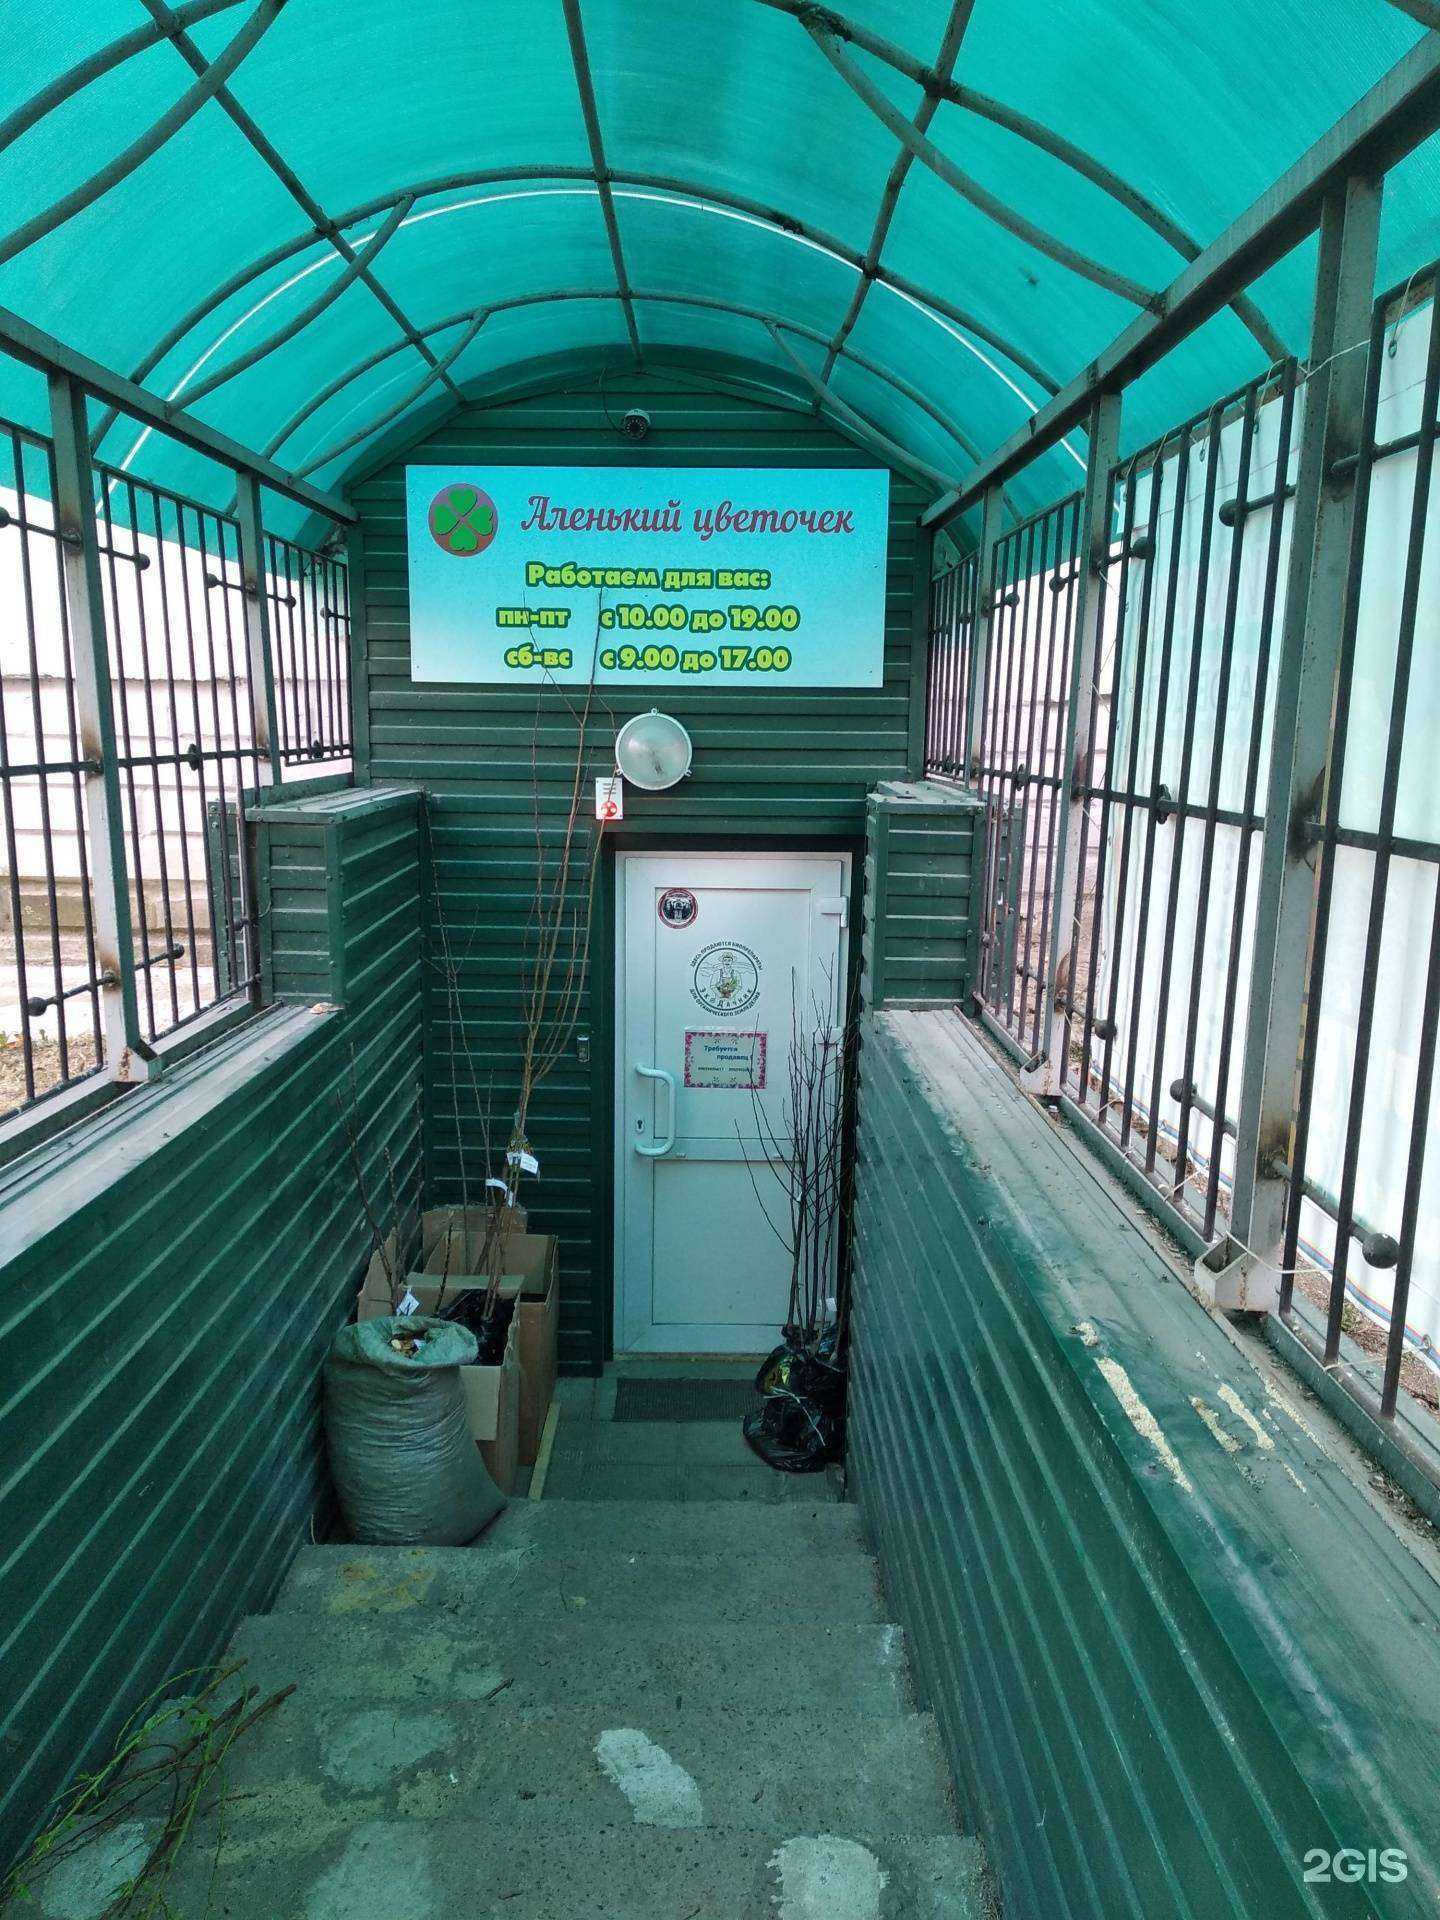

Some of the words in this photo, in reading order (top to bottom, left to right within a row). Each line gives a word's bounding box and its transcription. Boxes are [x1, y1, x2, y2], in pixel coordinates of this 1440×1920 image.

[520, 495, 682, 532] Аленький
[693, 500, 855, 541] цветочек
[526, 561, 660, 588] Работаем
[661, 568, 714, 592] для
[715, 568, 771, 589] вас:
[496, 607, 571, 628] пн-пт
[600, 609, 616, 629] с
[616, 603, 688, 630] 10.00
[689, 609, 727, 633] до
[728, 605, 800, 631] 19.00
[504, 642, 573, 669] сб-вс
[600, 648, 617, 670] с
[617, 644, 679, 670] 9.00
[680, 650, 717, 673] до
[718, 645, 792, 671] 17.00
